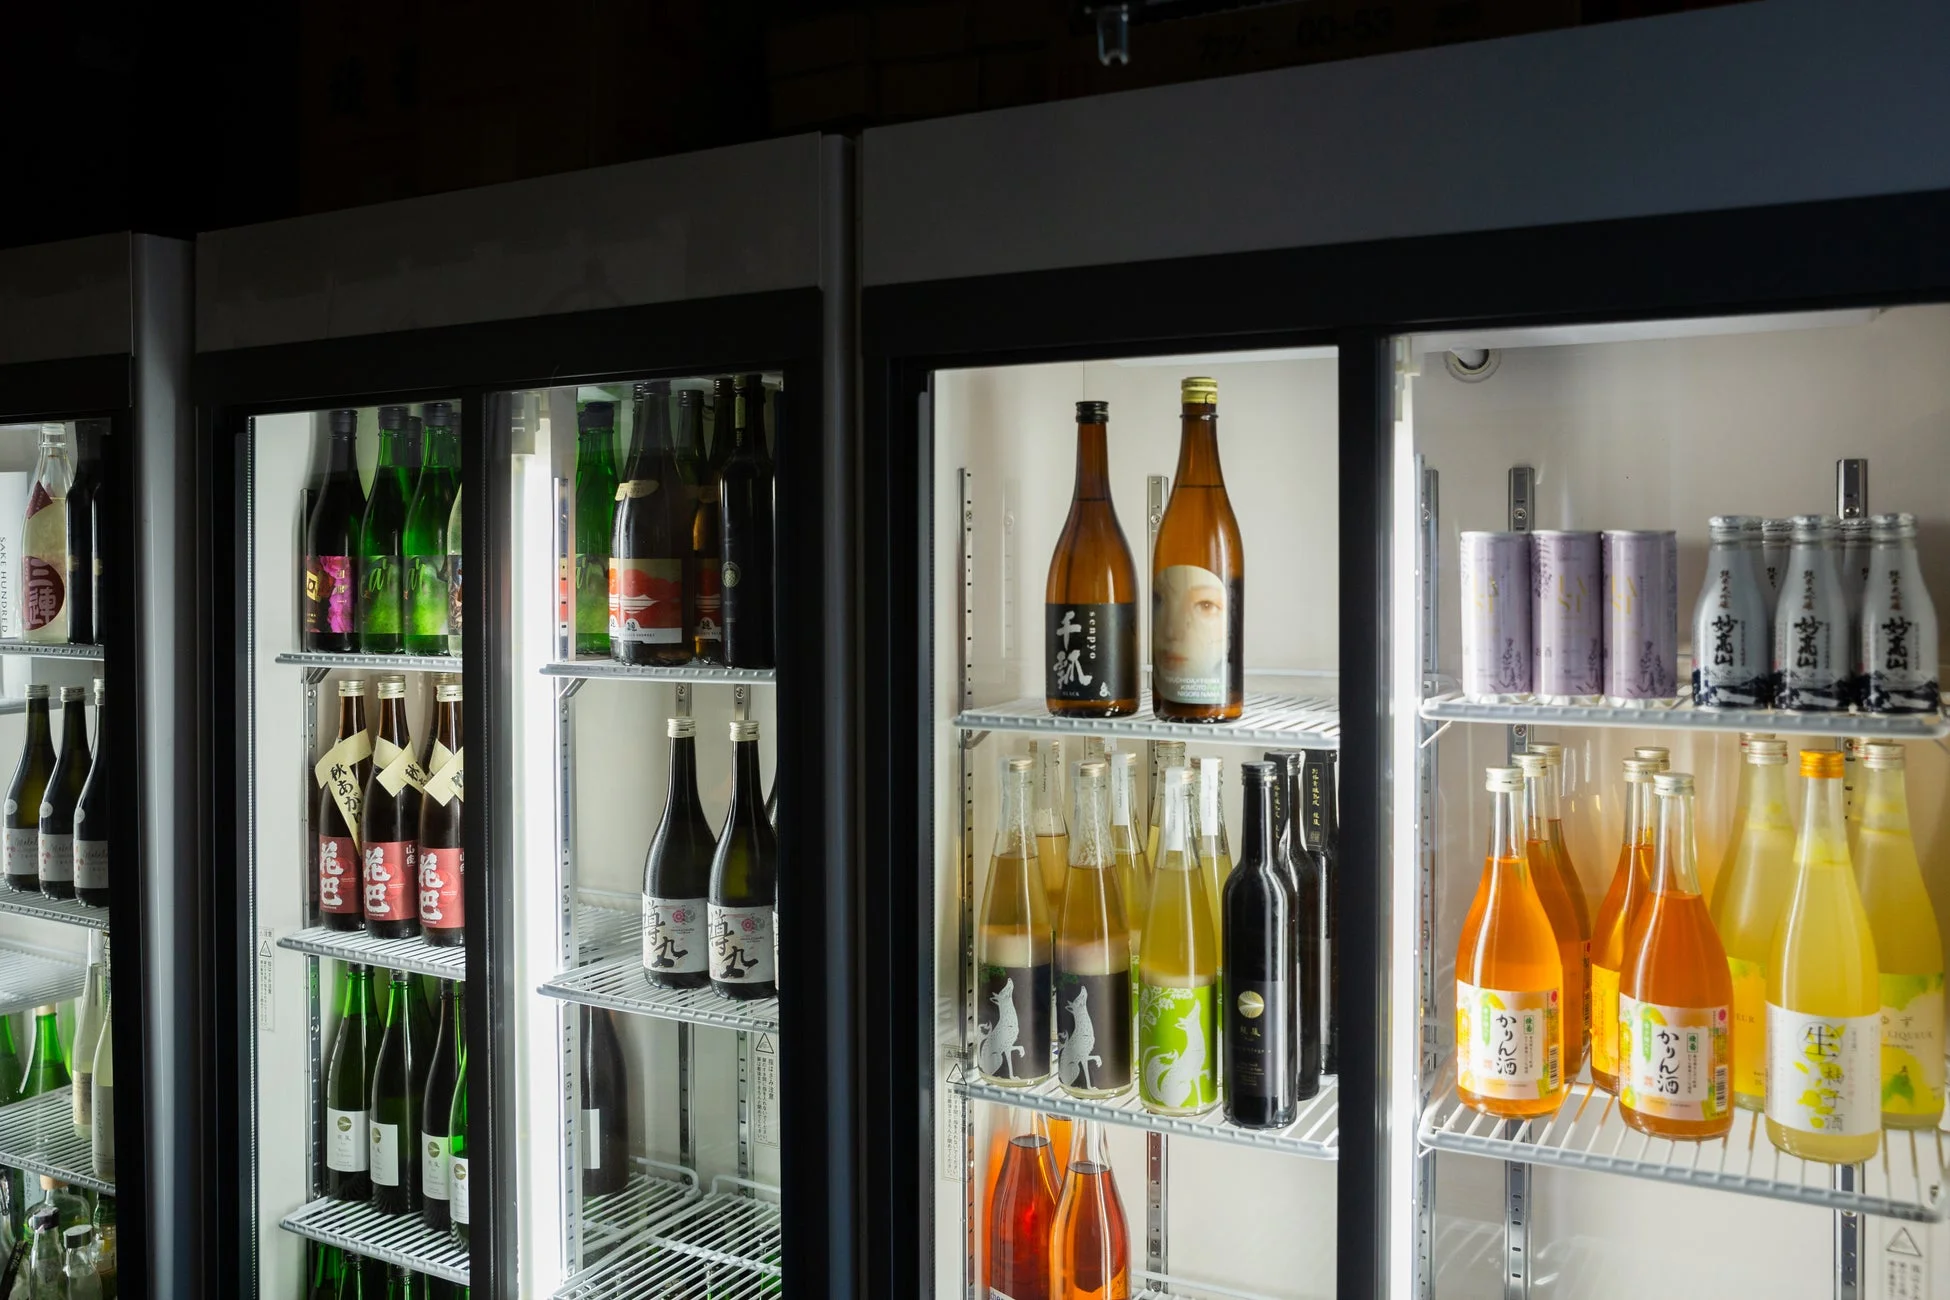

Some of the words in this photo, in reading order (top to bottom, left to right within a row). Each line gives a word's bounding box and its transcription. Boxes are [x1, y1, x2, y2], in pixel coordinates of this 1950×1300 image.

[1086, 611, 1097, 660] senpyo
[1711, 614, 1738, 667] 妙高山
[1794, 615, 1823, 669] 妙高山
[1882, 615, 1912, 670] 妙高山
[1496, 1013, 1518, 1076] かりん酒
[1657, 1029, 1680, 1095] かりん酒
